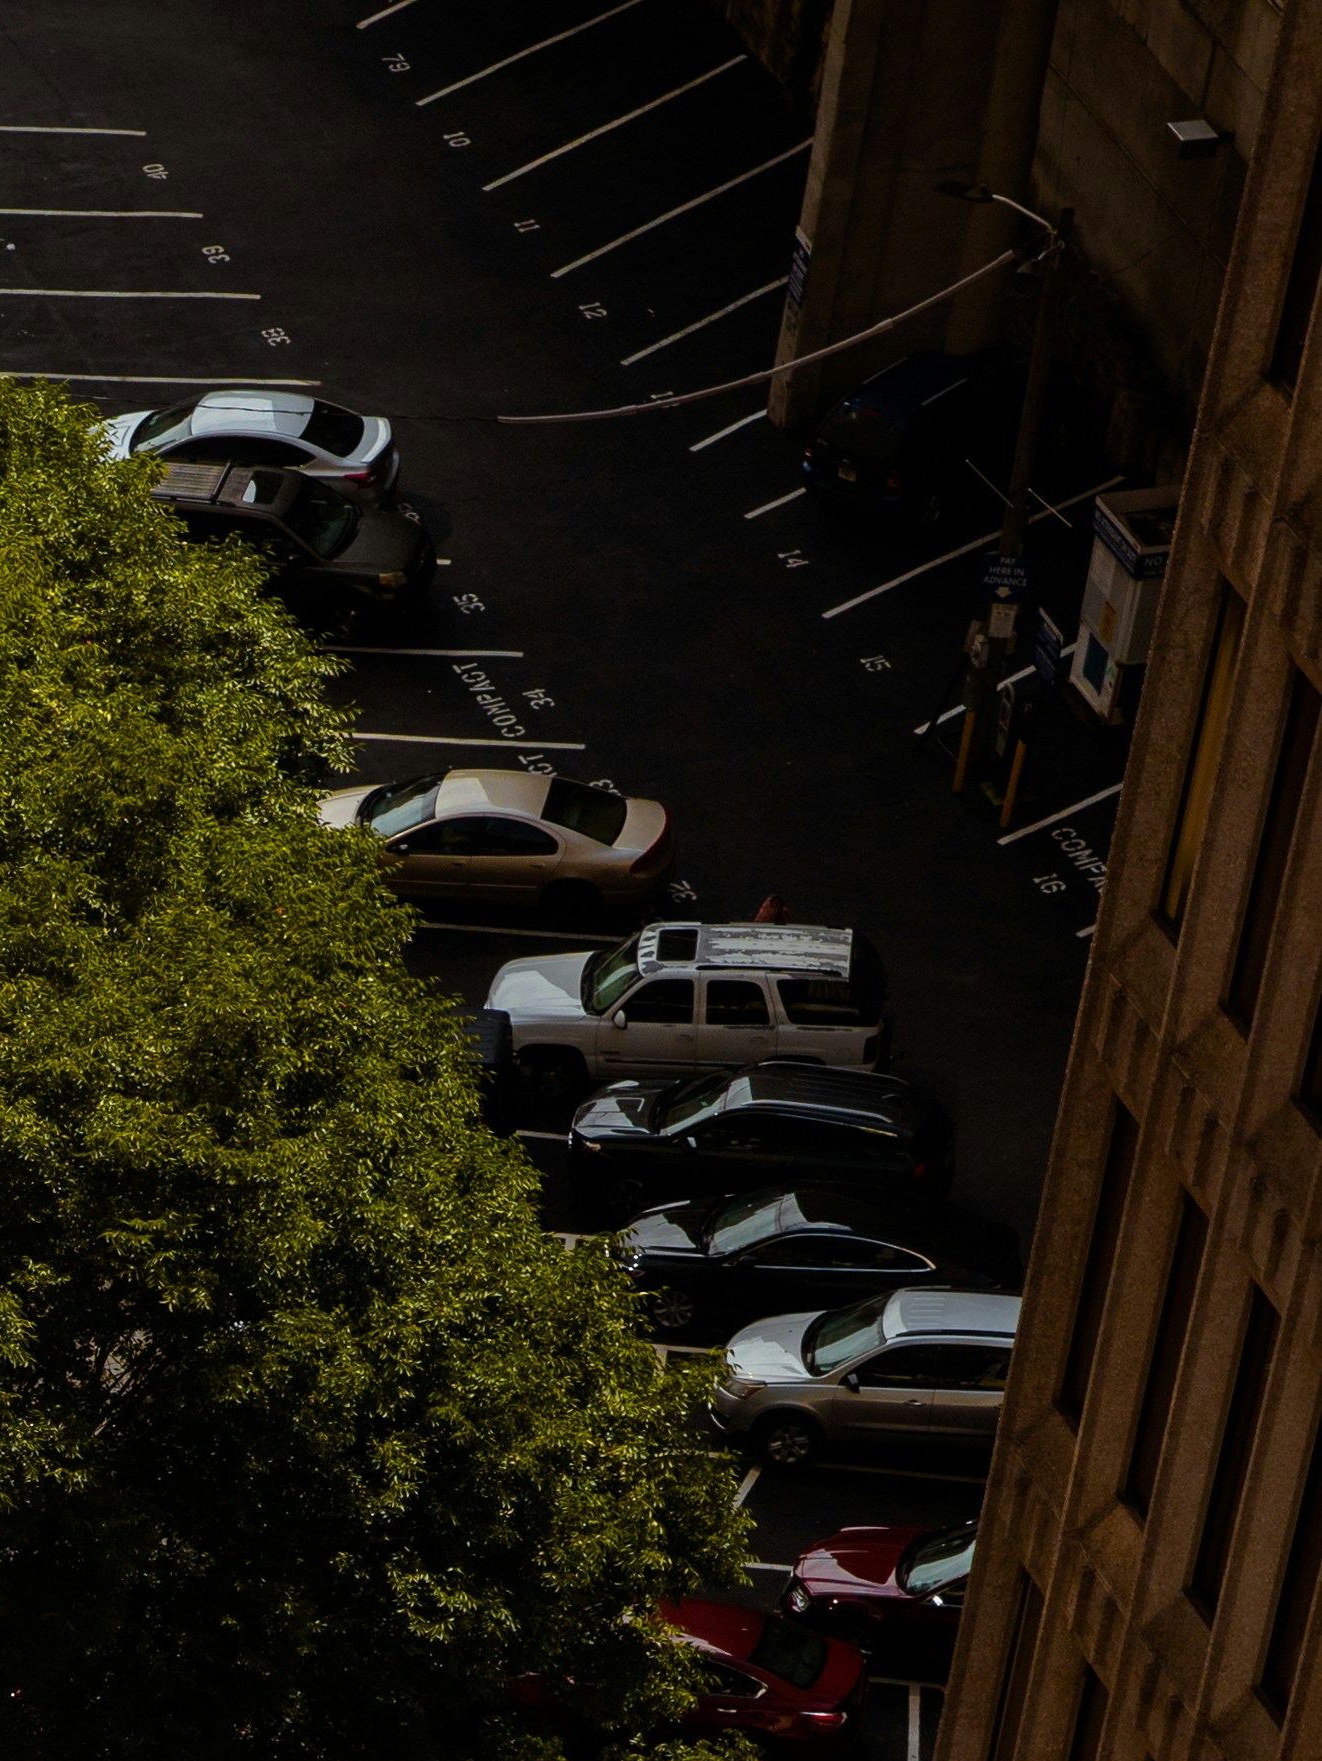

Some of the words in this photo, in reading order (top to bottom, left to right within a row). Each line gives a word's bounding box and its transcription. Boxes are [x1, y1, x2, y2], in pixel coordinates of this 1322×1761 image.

[381, 53, 411, 72] 79
[442, 131, 472, 147] 10
[142, 163, 169, 180] 40
[513, 219, 540, 233] 11
[201, 245, 231, 264] 39
[577, 302, 607, 319] 12
[777, 549, 809, 568] 14
[988, 566, 1013, 575] HERE
[1014, 567, 1025, 577] IN
[982, 576, 1028, 587] ADVANCE
[452, 593, 486, 614] 35
[860, 654, 891, 671] 15
[452, 662, 526, 738] COMPACT
[522, 688, 555, 710] 34
[1051, 828, 1108, 893] COMPA
[667, 880, 697, 903] 32
[1033, 873, 1067, 894] 16
